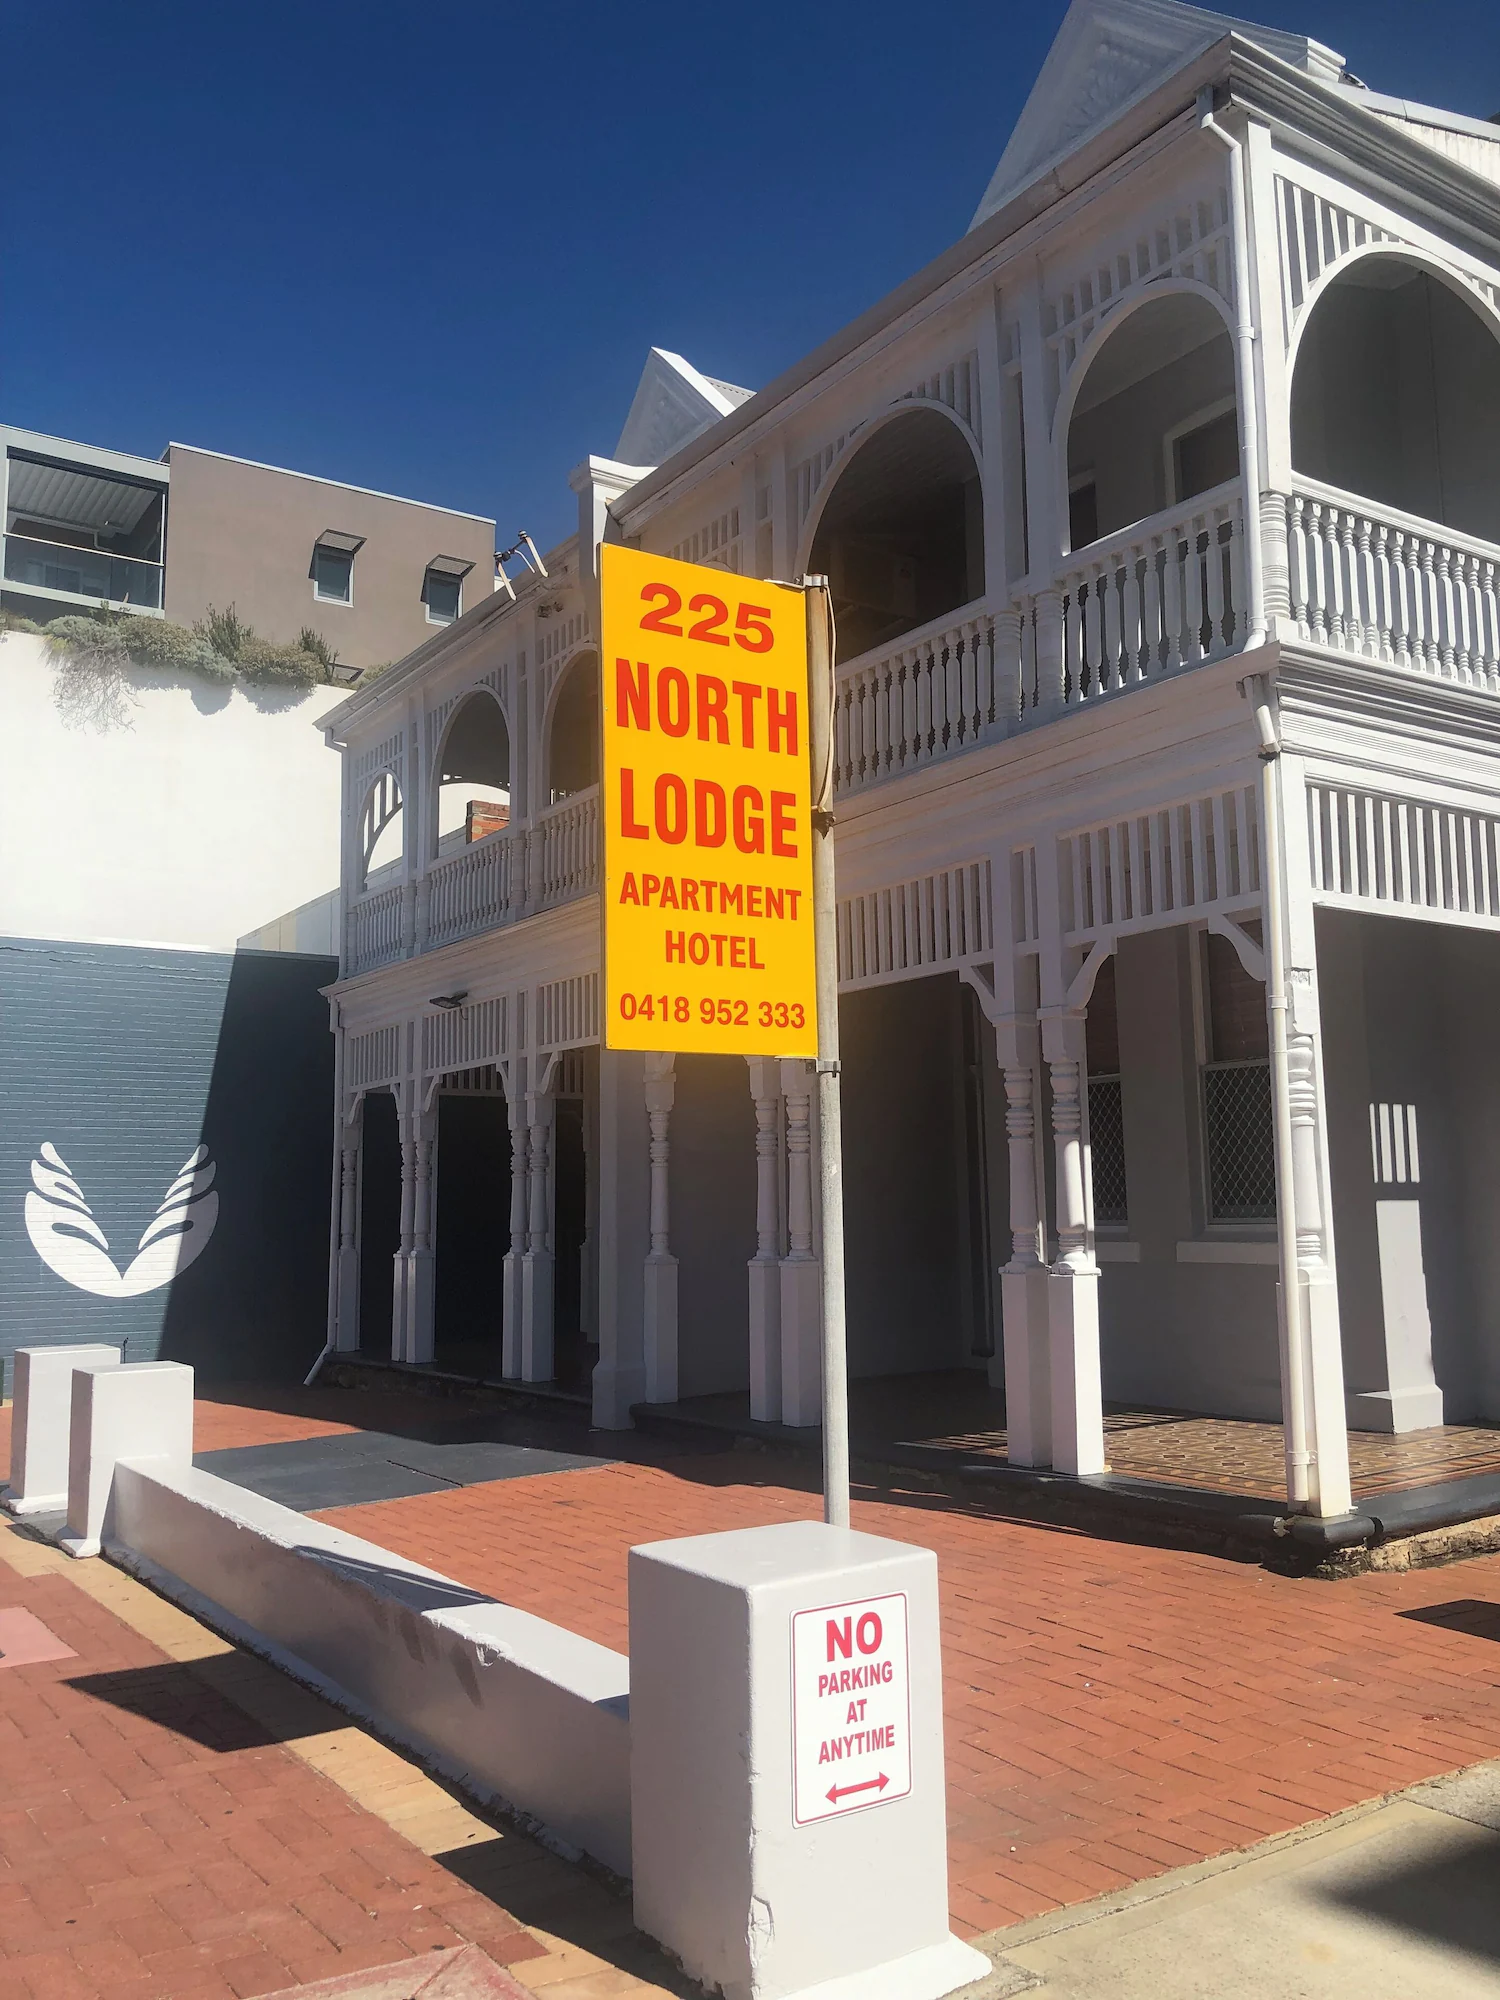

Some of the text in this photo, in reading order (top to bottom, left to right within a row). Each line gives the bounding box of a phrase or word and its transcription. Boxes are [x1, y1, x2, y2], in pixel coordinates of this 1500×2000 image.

[639, 582, 775, 654] 225
[615, 658, 799, 757] NORTH
[620, 768, 799, 859] LODGE
[619, 872, 802, 921] APARTMENT
[665, 930, 766, 970] HOTEL
[619, 992, 806, 1030] 0418 952 333
[826, 1611, 883, 1662] NO
[818, 1660, 893, 1697] PARKING
[846, 1698, 868, 1724] AT
[818, 1724, 895, 1765] ANYTIME
